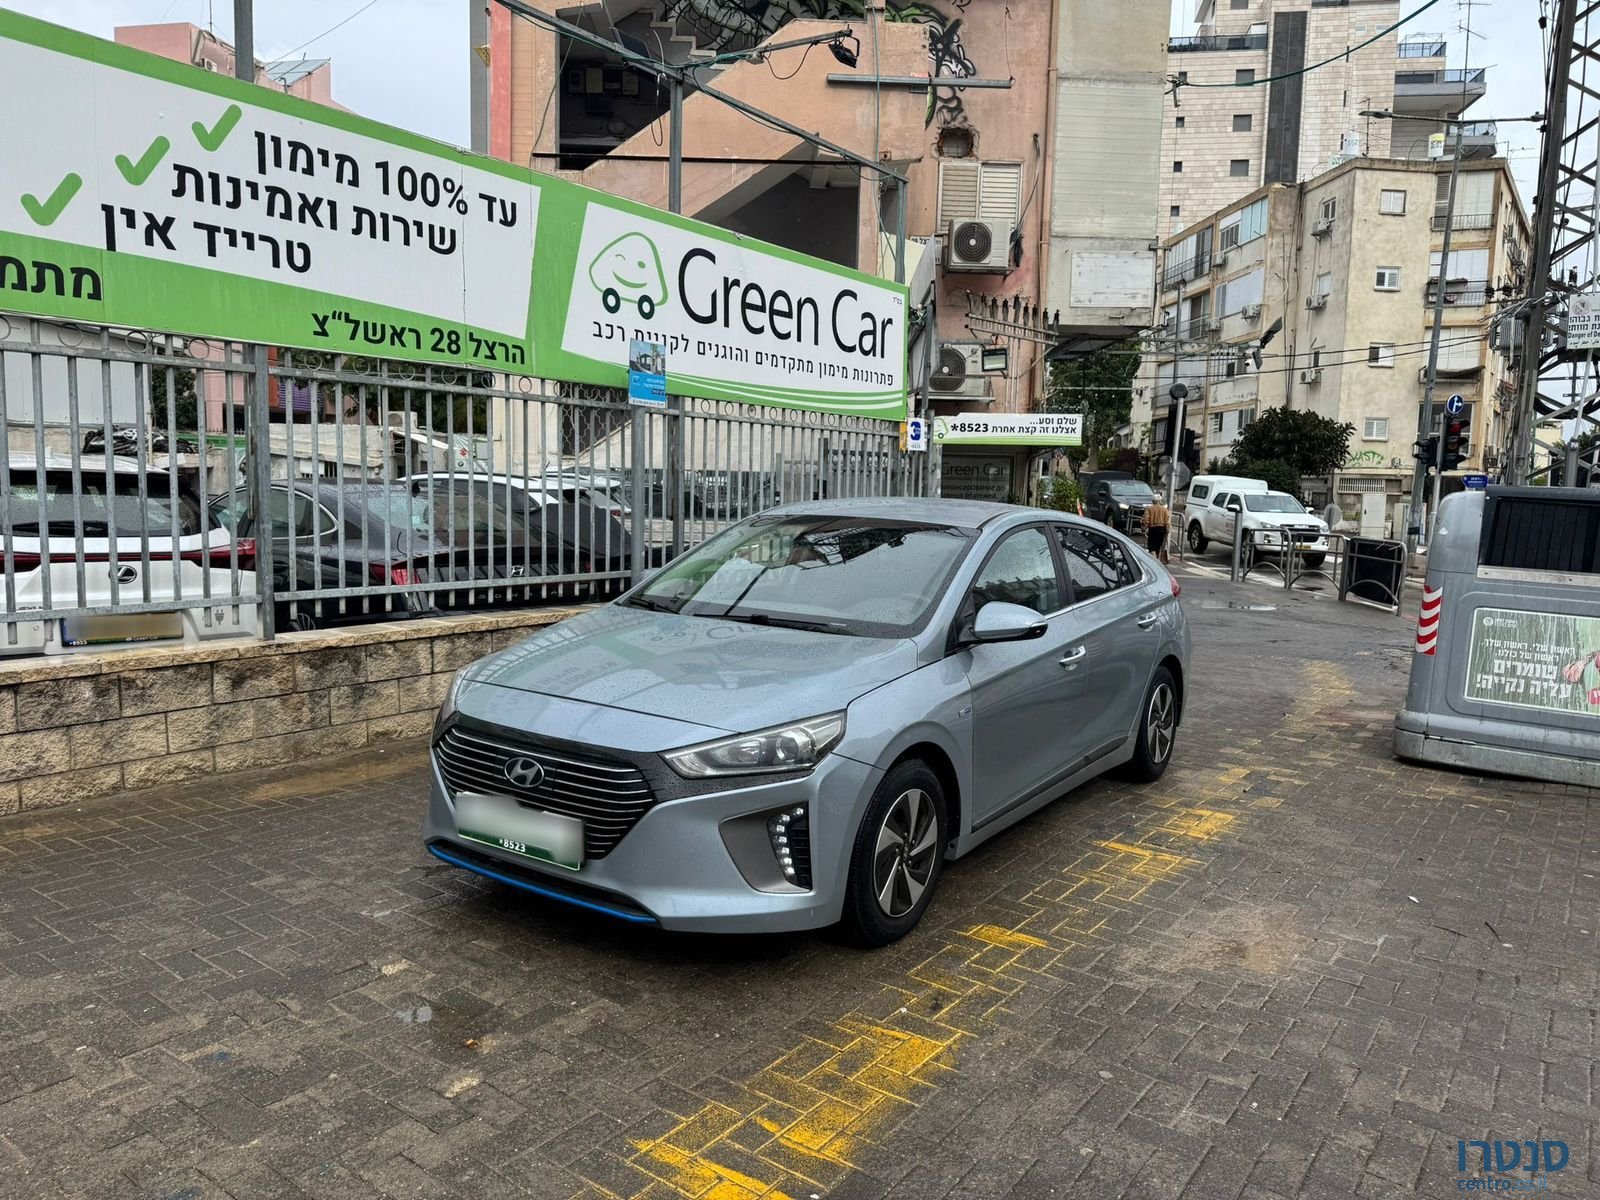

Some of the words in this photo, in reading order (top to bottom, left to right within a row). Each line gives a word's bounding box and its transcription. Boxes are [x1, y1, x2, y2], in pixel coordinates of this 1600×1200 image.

[254, 130, 360, 188] מימון
[171, 163, 338, 231] ואמינות
[376, 161, 468, 216] 100%
[479, 193, 517, 227] עד
[101, 203, 176, 252] אין
[352, 206, 456, 255] שירות
[193, 222, 311, 273] טרייד
[678, 247, 819, 346] Green
[831, 289, 893, 360] Car
[1568, 323, 1589, 332] מוות!
[1569, 315, 1591, 323] גבוה!
[311, 310, 422, 350] ראשל"צ
[592, 321, 626, 342] רכב
[430, 327, 461, 355] 28
[469, 331, 525, 365] הרצל
[697, 340, 749, 363] והוגנים
[755, 351, 814, 374] מתקדמים
[819, 361, 848, 379] מימון
[852, 368, 894, 386] פתרונות
[991, 425, 1016, 433] אחרת
[1018, 426, 1037, 435] קצת
[1039, 426, 1049, 434] זה
[1052, 425, 1077, 434] אצלנו
[1056, 417, 1077, 425] שלם
[942, 462, 980, 476] Green
[982, 462, 1006, 476] Car
[1504, 640, 1528, 651] ראשון
[1520, 650, 1532, 660] של
[1550, 645, 1576, 655] ראשון
[1534, 653, 1559, 663] ראשון
[1493, 659, 1558, 680] שומרים
[1476, 673, 1526, 694] נקייה!
[1529, 679, 1573, 698] עליה
